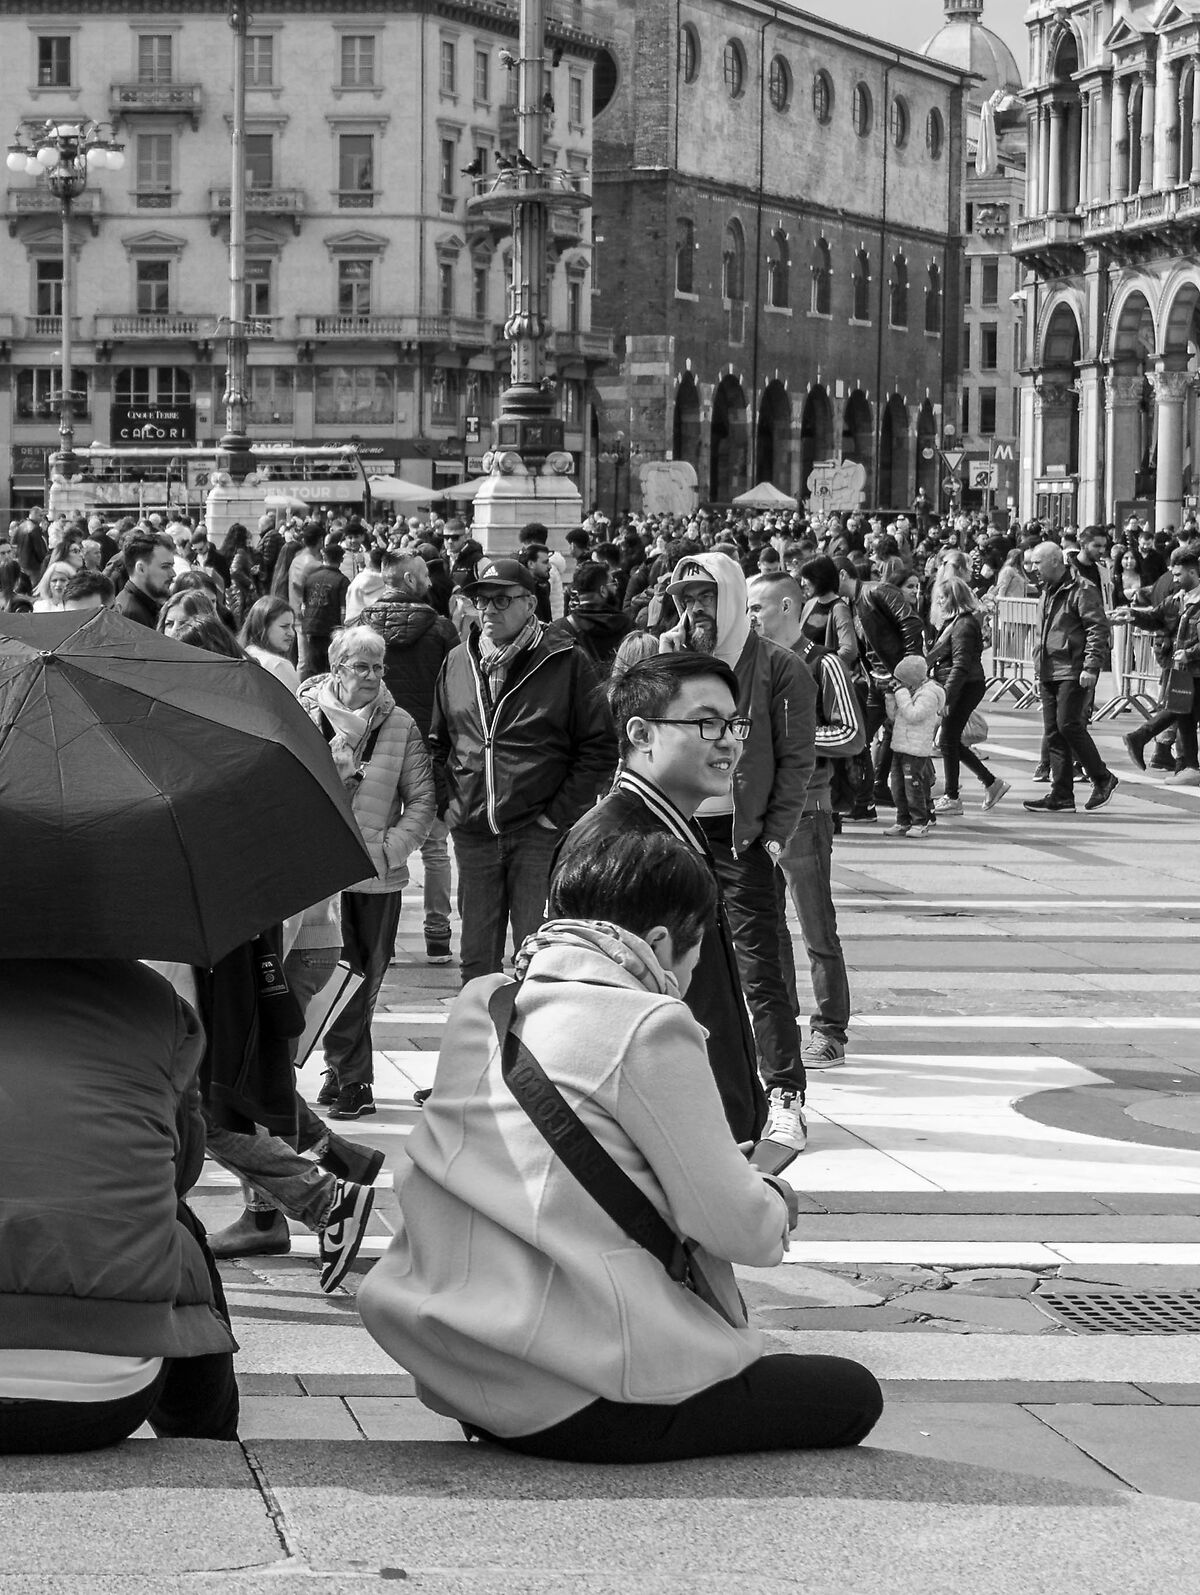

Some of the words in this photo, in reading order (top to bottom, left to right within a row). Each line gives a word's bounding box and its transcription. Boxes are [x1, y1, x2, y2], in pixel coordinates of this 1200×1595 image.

[120, 427, 185, 438] CALORI
[994, 444, 1014, 460] M
[289, 486, 331, 498] TOUR
